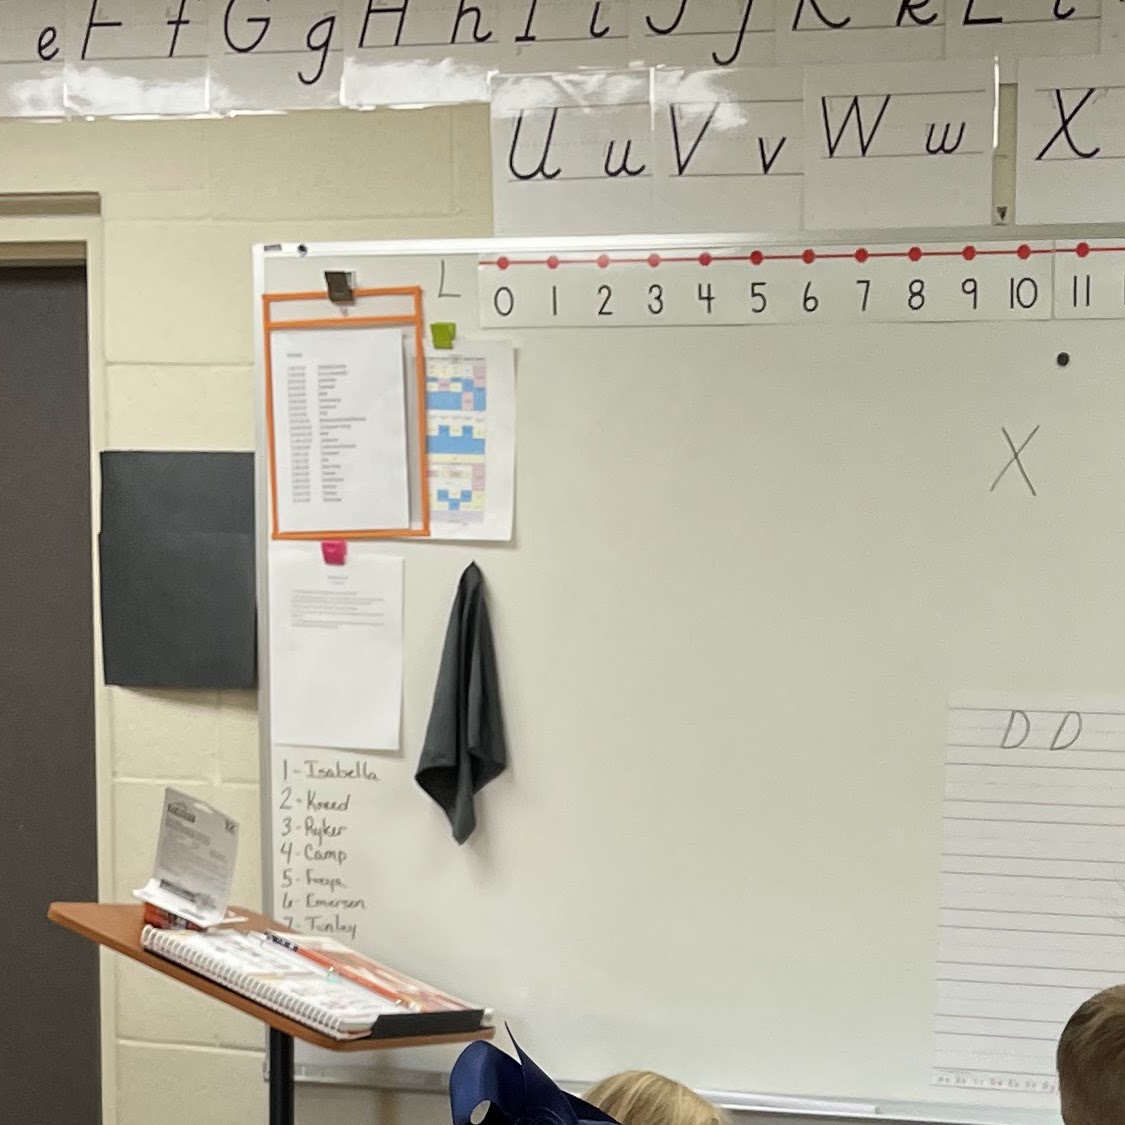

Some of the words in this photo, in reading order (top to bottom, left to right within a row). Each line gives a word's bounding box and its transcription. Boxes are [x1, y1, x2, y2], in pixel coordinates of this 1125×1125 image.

[38, 26, 60, 61] e
[223, 0, 271, 53] G
[297, 15, 337, 85] g
[509, 106, 562, 181] U
[603, 138, 646, 178] u
[669, 102, 721, 177] V
[757, 136, 787, 175] v
[821, 93, 892, 159] W
[924, 120, 967, 155] w
[1034, 87, 1101, 161] X
[437, 259, 462, 299] L
[494, 286, 515, 317] 0
[551, 285, 558, 317] 1
[596, 284, 613, 316] 2
[646, 283, 664, 315] 3
[698, 282, 716, 314] 4
[749, 281, 768, 314] 5
[801, 280, 819, 313] 6
[854, 279, 871, 311] 7
[907, 278, 926, 310] 8
[960, 277, 979, 310] 9
[1009, 276, 1038, 309] 10
[1072, 273, 1091, 308] 11
[990, 424, 1041, 497] X
[1000, 709, 1031, 750] D
[1050, 711, 1083, 751] D
[303, 842, 348, 867] Camp
